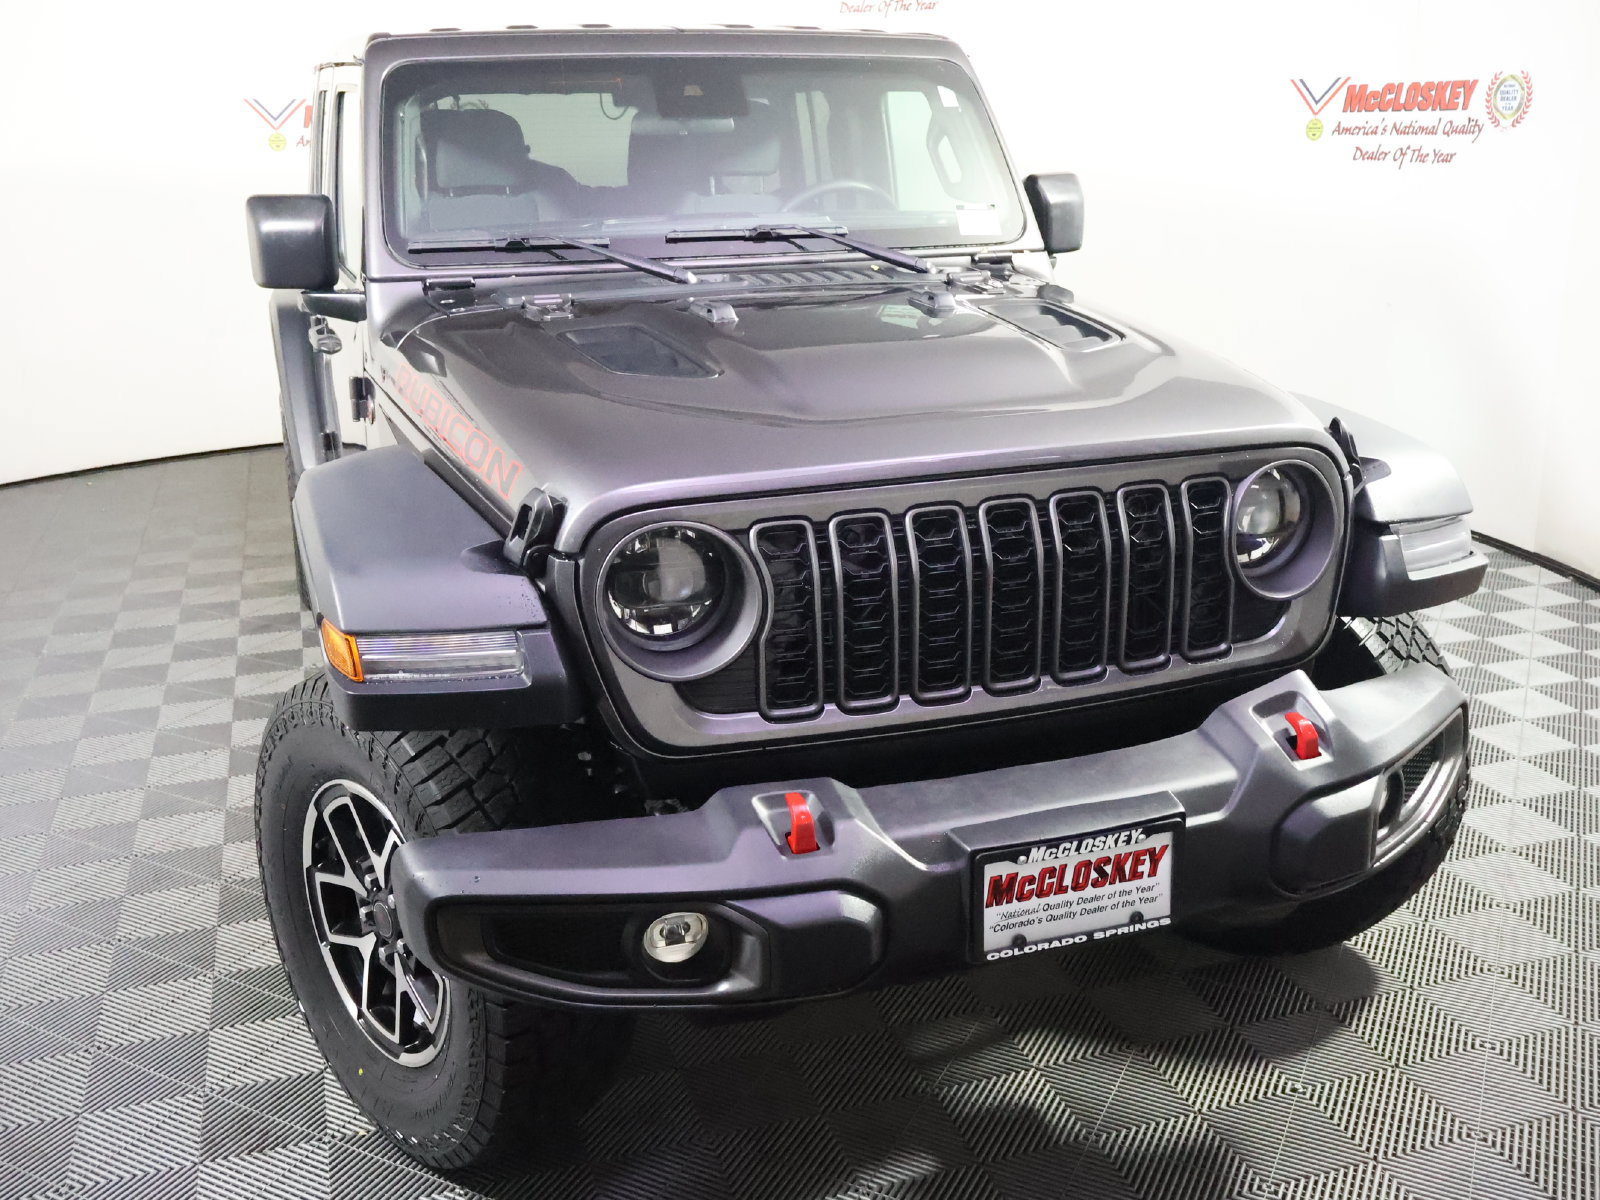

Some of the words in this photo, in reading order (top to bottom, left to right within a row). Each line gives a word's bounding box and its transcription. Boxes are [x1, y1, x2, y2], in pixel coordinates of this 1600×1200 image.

[840, 0, 874, 13] Dealer
[894, 0, 912, 12] The
[915, 0, 938, 12] Year
[1343, 79, 1479, 113] McCLOSKEY
[1331, 118, 1388, 137] America's
[1390, 117, 1441, 137] National
[1442, 117, 1484, 144] Quality
[1353, 144, 1391, 161] Dealer
[1392, 144, 1411, 170] Of
[1409, 146, 1430, 163] The
[1431, 148, 1457, 164] Year
[395, 362, 524, 500] RUBICON
[1027, 828, 1144, 864] McCLOSKEY
[985, 844, 1169, 909] McCLOSKEY
[1042, 898, 1074, 912] Quality
[1077, 893, 1105, 906] Dealer
[1107, 890, 1117, 900] of
[1118, 888, 1132, 898] the
[1045, 909, 1077, 923] Quality
[1079, 904, 1108, 917] Dealer
[1110, 900, 1120, 911] of
[1121, 898, 1136, 908] the
[986, 934, 1088, 961] COLORADO
[1093, 917, 1172, 940] SPRINGS
